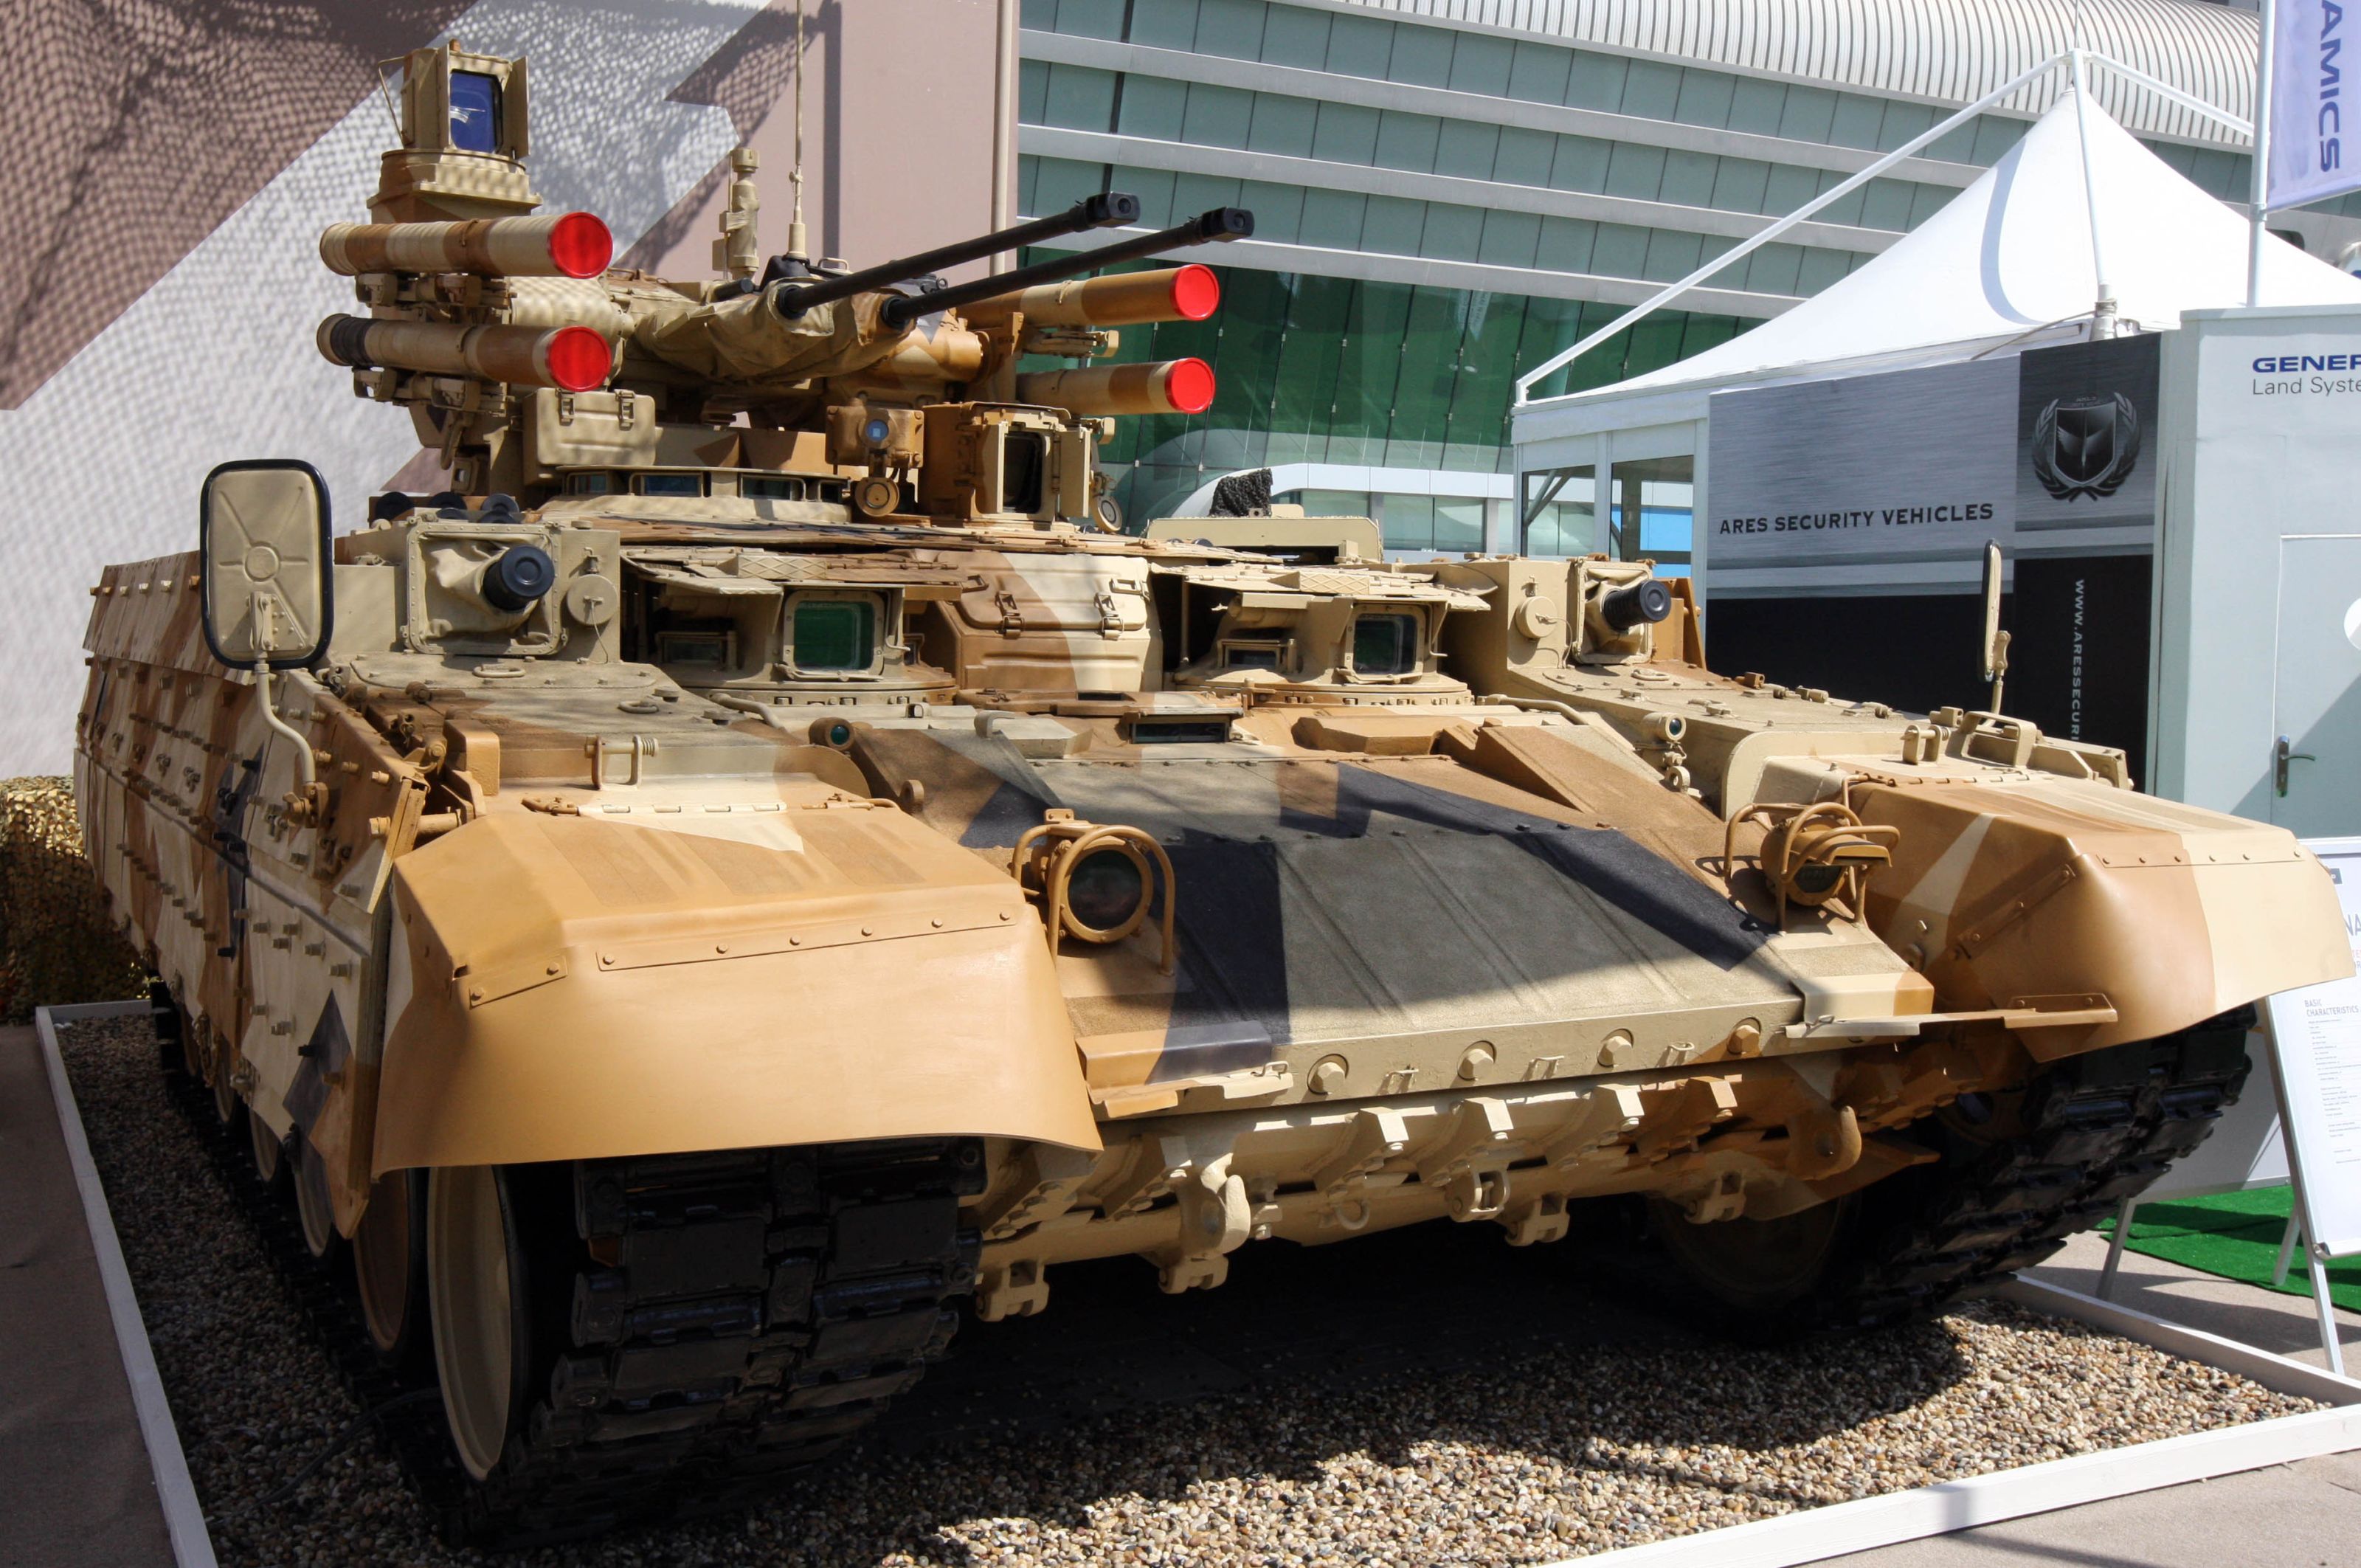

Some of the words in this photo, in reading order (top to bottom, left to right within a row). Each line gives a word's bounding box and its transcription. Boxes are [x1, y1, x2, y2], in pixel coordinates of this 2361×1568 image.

[2318, 0, 2343, 172] AMICS
[2253, 378, 2302, 395] Land
[1720, 518, 1768, 534] ARES
[1774, 511, 1875, 531] SECURITY
[1881, 503, 1994, 525] VEHICLES
